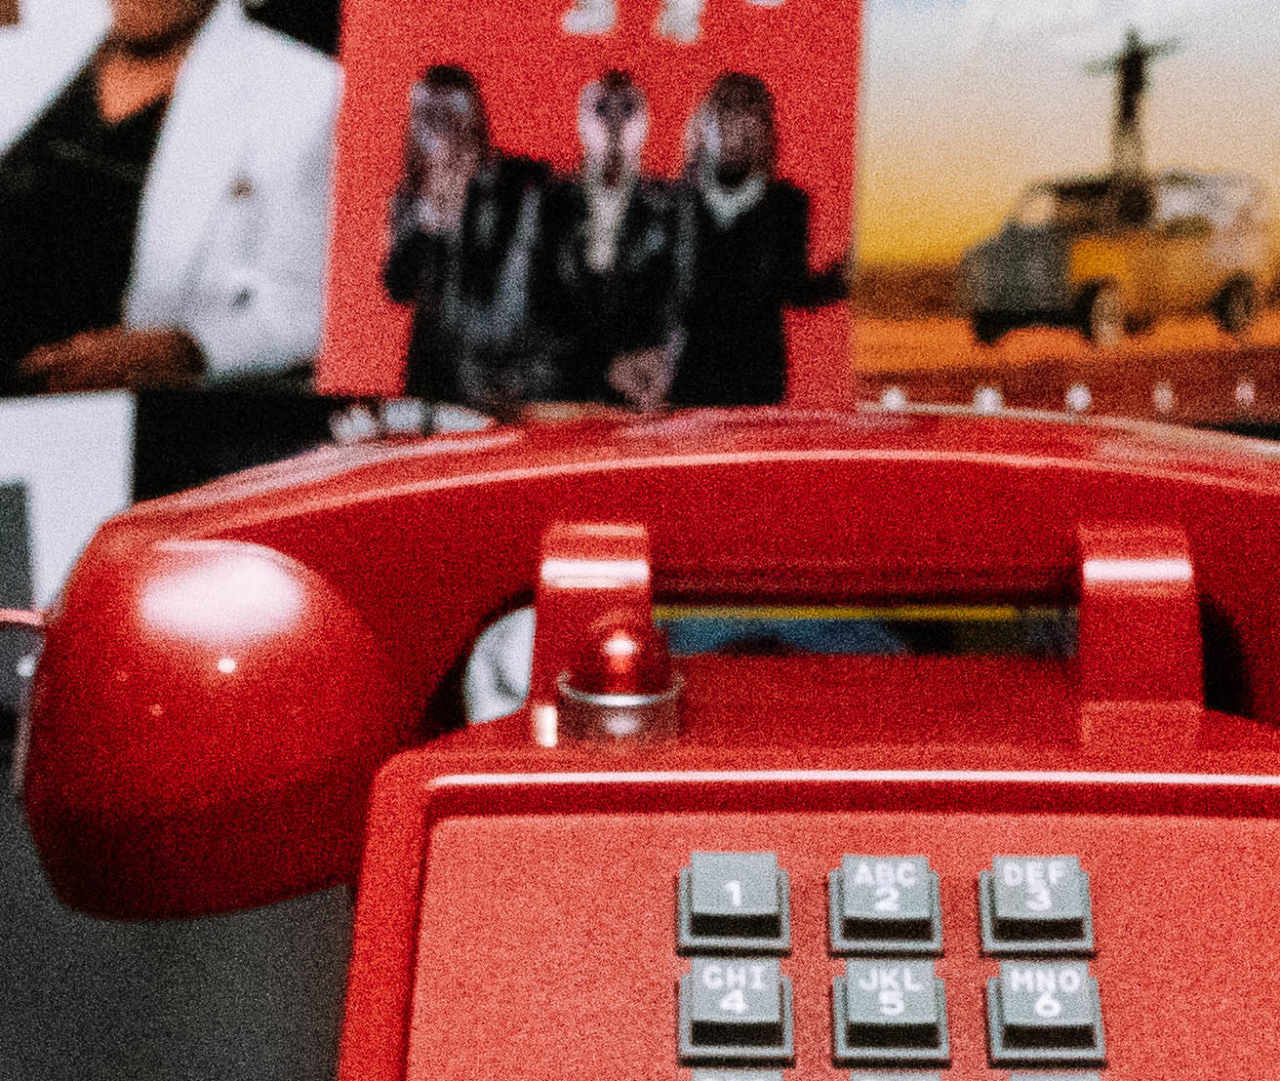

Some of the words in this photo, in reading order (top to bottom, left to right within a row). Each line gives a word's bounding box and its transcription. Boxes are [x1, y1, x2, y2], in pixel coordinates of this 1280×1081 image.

[853, 860, 917, 888] ABC
[1002, 861, 1066, 887] DEF
[723, 878, 743, 907] 1
[875, 886, 900, 912] 2
[1026, 883, 1053, 911] 3
[702, 966, 765, 990] GHI
[858, 966, 920, 990] JKL
[1009, 967, 1081, 992] MNO
[720, 990, 746, 1013] 4
[879, 990, 905, 1017] 5
[1035, 992, 1061, 1018] 6
